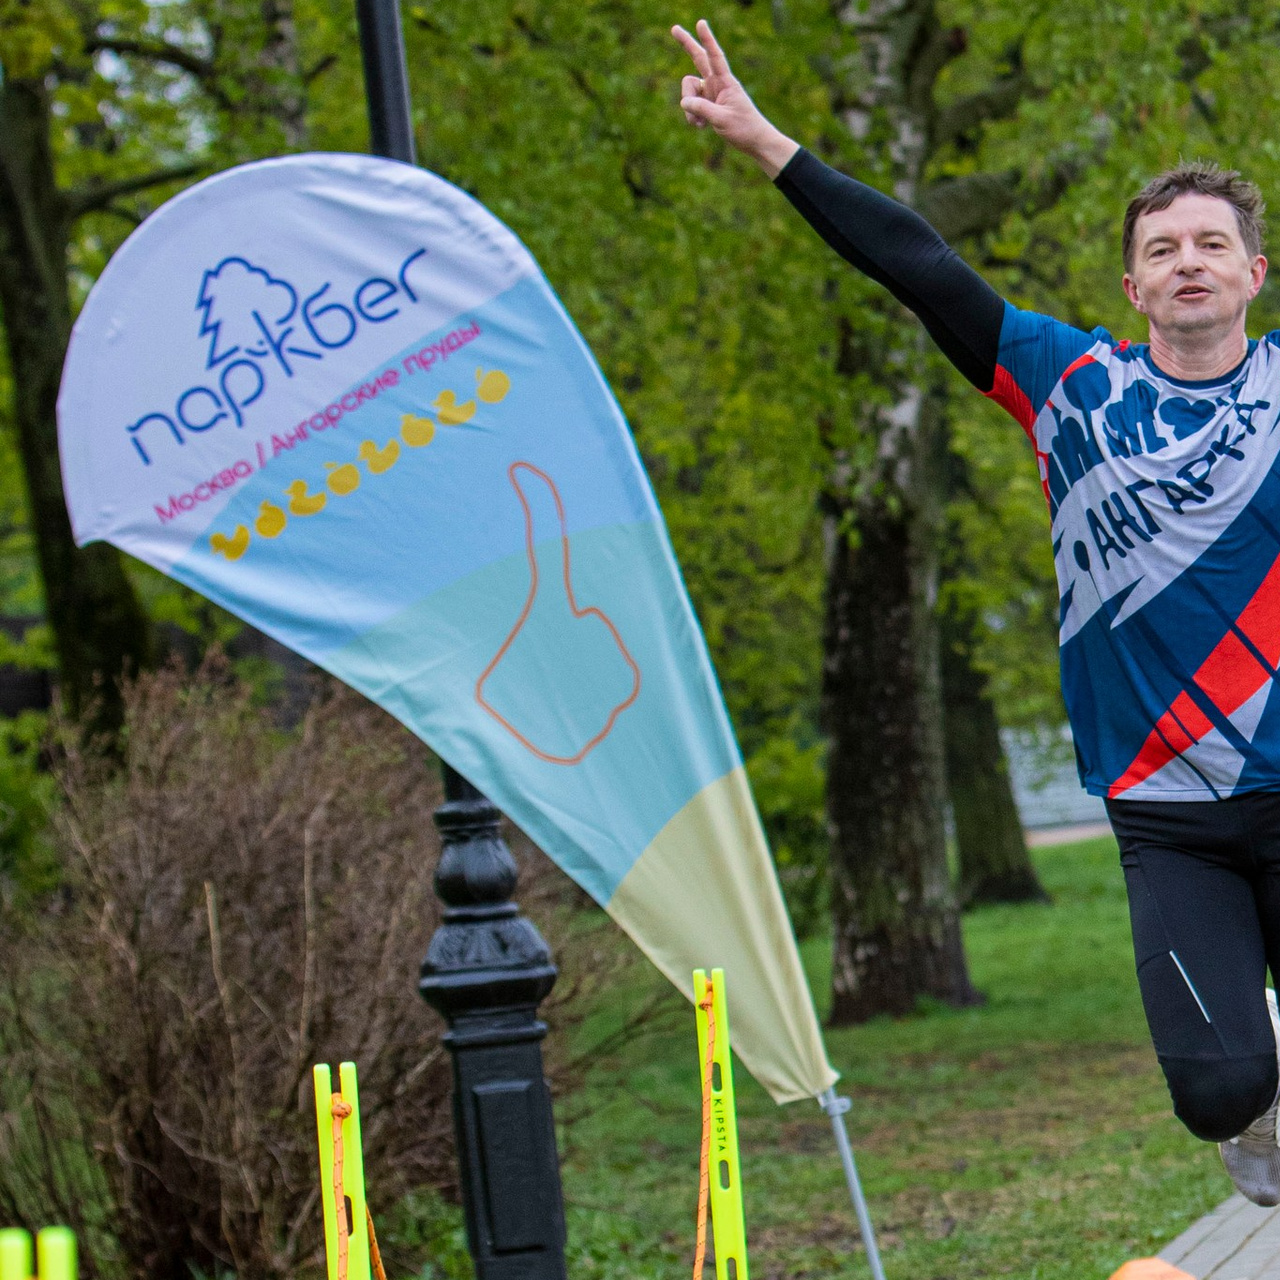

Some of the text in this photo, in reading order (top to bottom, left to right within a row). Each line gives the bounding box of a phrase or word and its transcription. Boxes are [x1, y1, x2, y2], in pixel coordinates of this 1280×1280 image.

[153, 459, 254, 525] Москва
[269, 367, 402, 458] Ангарские
[401, 318, 483, 377] пруды
[1085, 398, 1271, 571] АНГАРКА
[713, 1098, 727, 1152] KIPSTA
